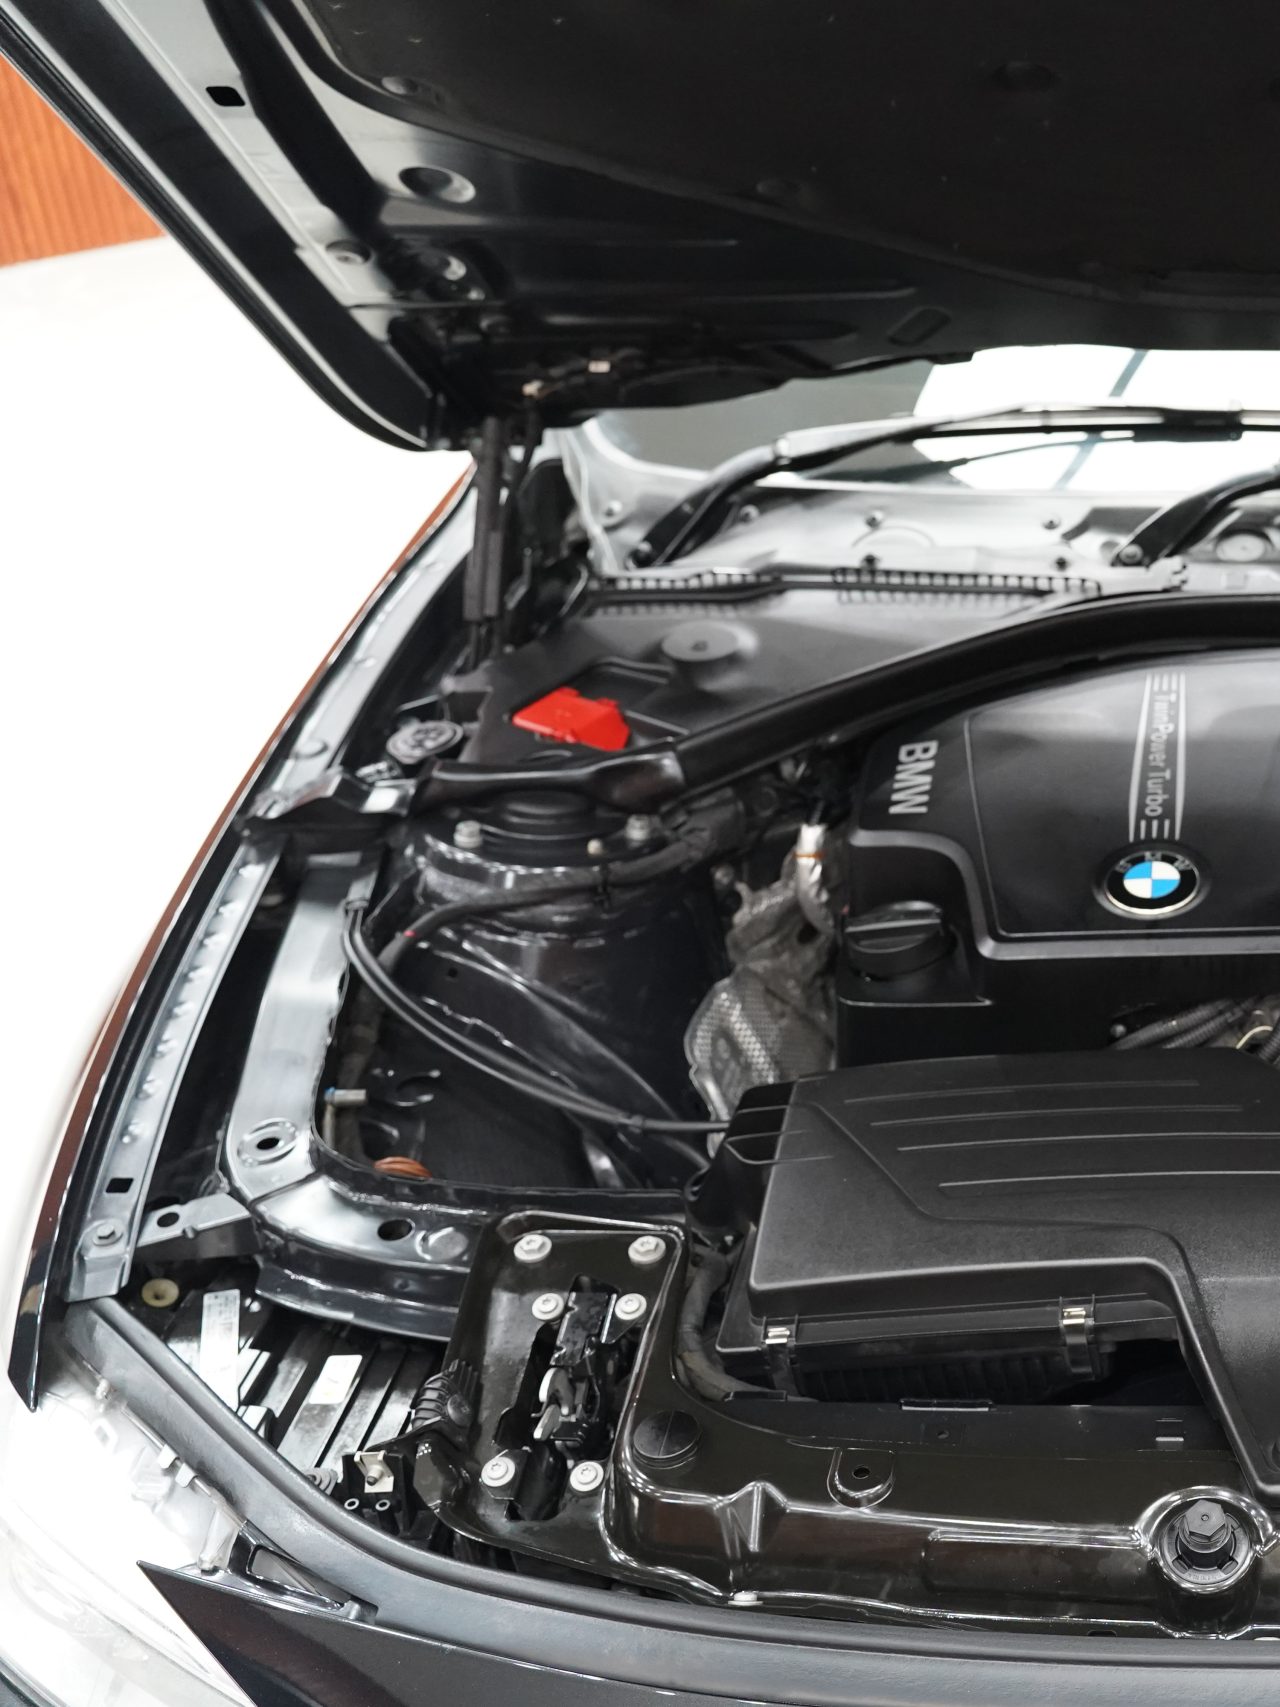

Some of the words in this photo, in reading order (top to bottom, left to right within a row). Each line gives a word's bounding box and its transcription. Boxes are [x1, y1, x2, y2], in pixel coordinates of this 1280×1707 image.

[1148, 692, 1177, 767] TwinPower
[888, 740, 939, 815] BMW
[1144, 768, 1171, 817] Turbo
